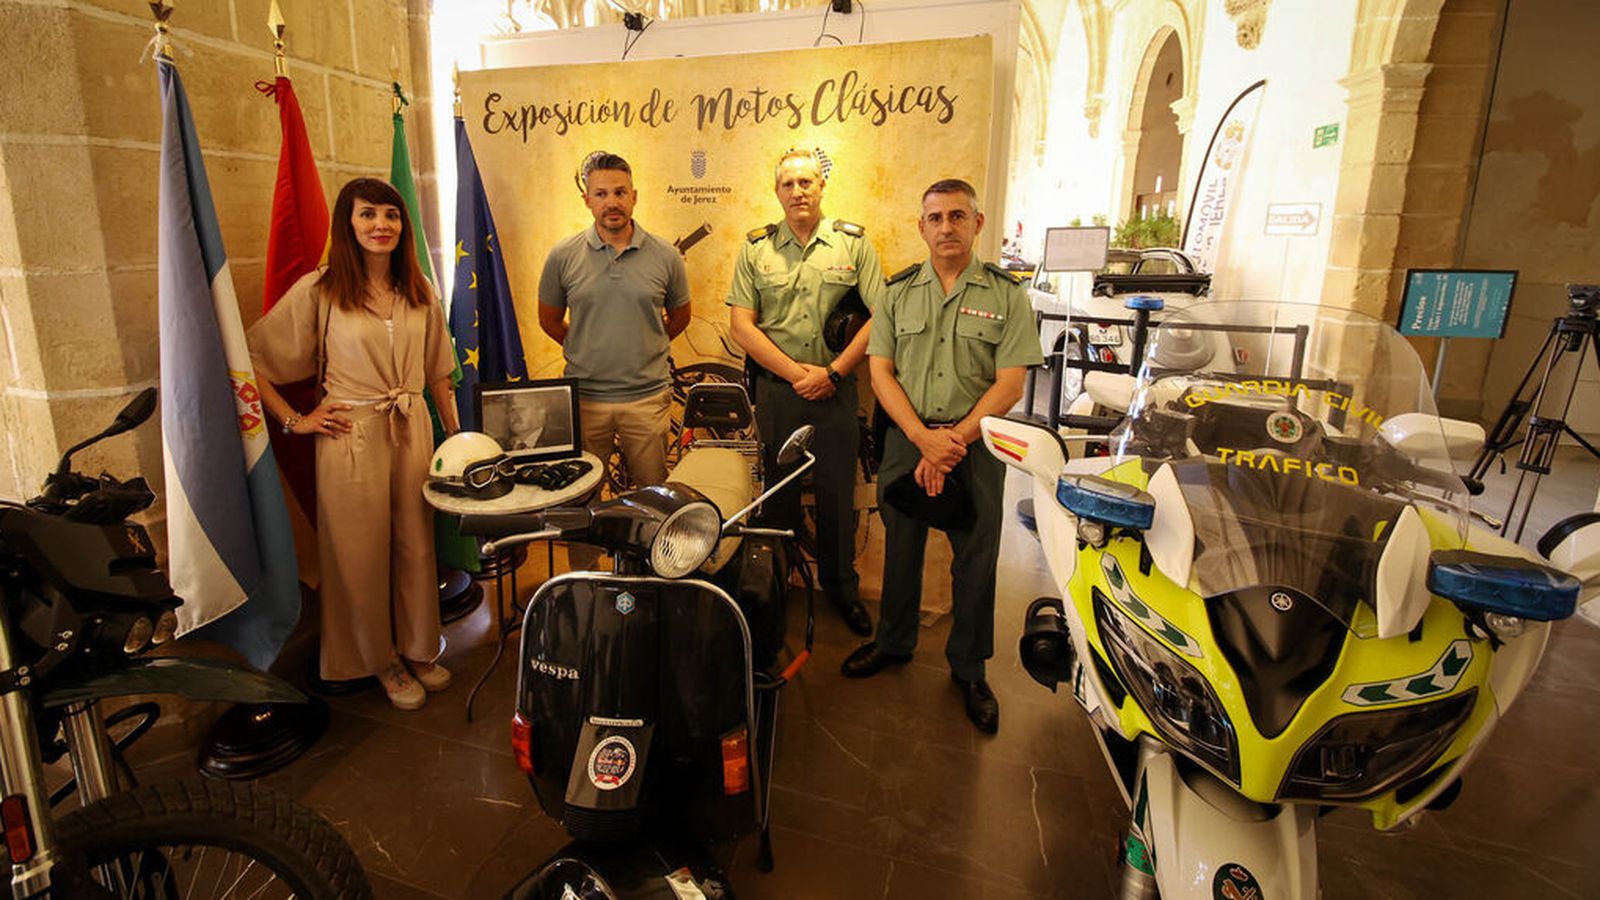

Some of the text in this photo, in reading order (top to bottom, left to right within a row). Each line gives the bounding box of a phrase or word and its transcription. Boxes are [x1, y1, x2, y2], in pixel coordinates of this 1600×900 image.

[483, 69, 958, 144] Exposición de Motos Clásicas
[667, 184, 732, 195] Ayuntamiento
[680, 194, 717, 205] de Jerez
[1185, 380, 1386, 433] GUARDIA CIVIL
[1216, 447, 1360, 486] TRAFICO
[530, 659, 580, 680] vespa
